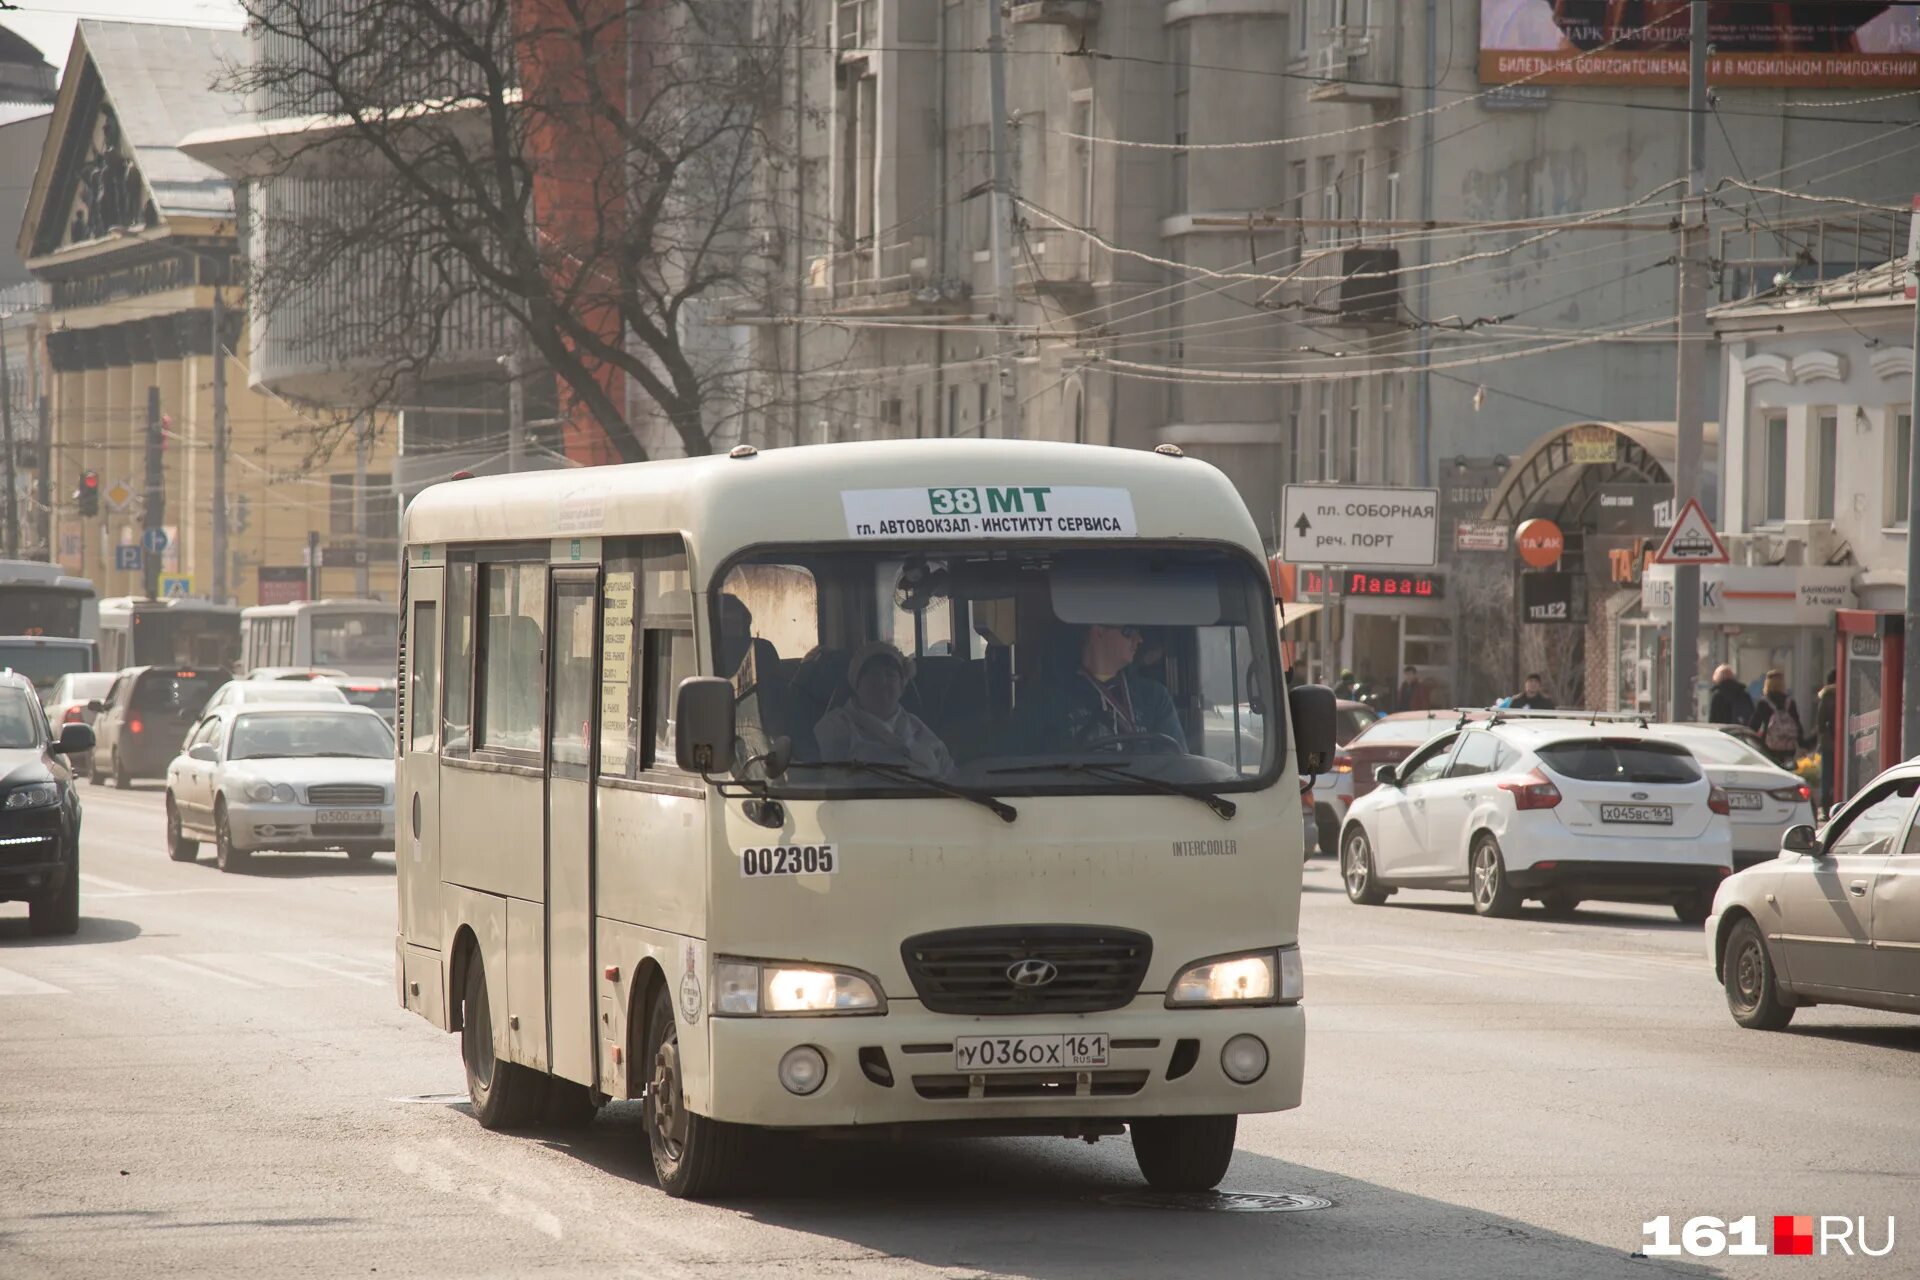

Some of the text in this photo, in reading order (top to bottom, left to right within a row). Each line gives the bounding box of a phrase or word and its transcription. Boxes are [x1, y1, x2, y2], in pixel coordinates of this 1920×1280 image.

[1499, 57, 1552, 73] БИЛЕТЫ
[1737, 60, 1822, 76] МОБИЛЬНОМ
[1826, 60, 1917, 76] ПРИЛОЖЕНИИ
[932, 487, 1051, 514] 38 МТ
[1317, 503, 1435, 518] пл. СОБОРНАЯ
[856, 523, 876, 536] гл.
[879, 519, 971, 535] АВТОВОКЗАЛ
[982, 517, 1053, 533] ИНСТИТУТ
[1058, 516, 1122, 532] СЕРВИСА
[1316, 534, 1394, 548] реч. ПОРТ
[1350, 573, 1433, 595] Лаваш
[1529, 601, 1567, 619] TELE2
[1606, 807, 1650, 820] Х045ВС
[1172, 840, 1238, 857] INTERCOOLER
[743, 845, 834, 875] 002305
[963, 1036, 1104, 1066] У036ОХ 161
